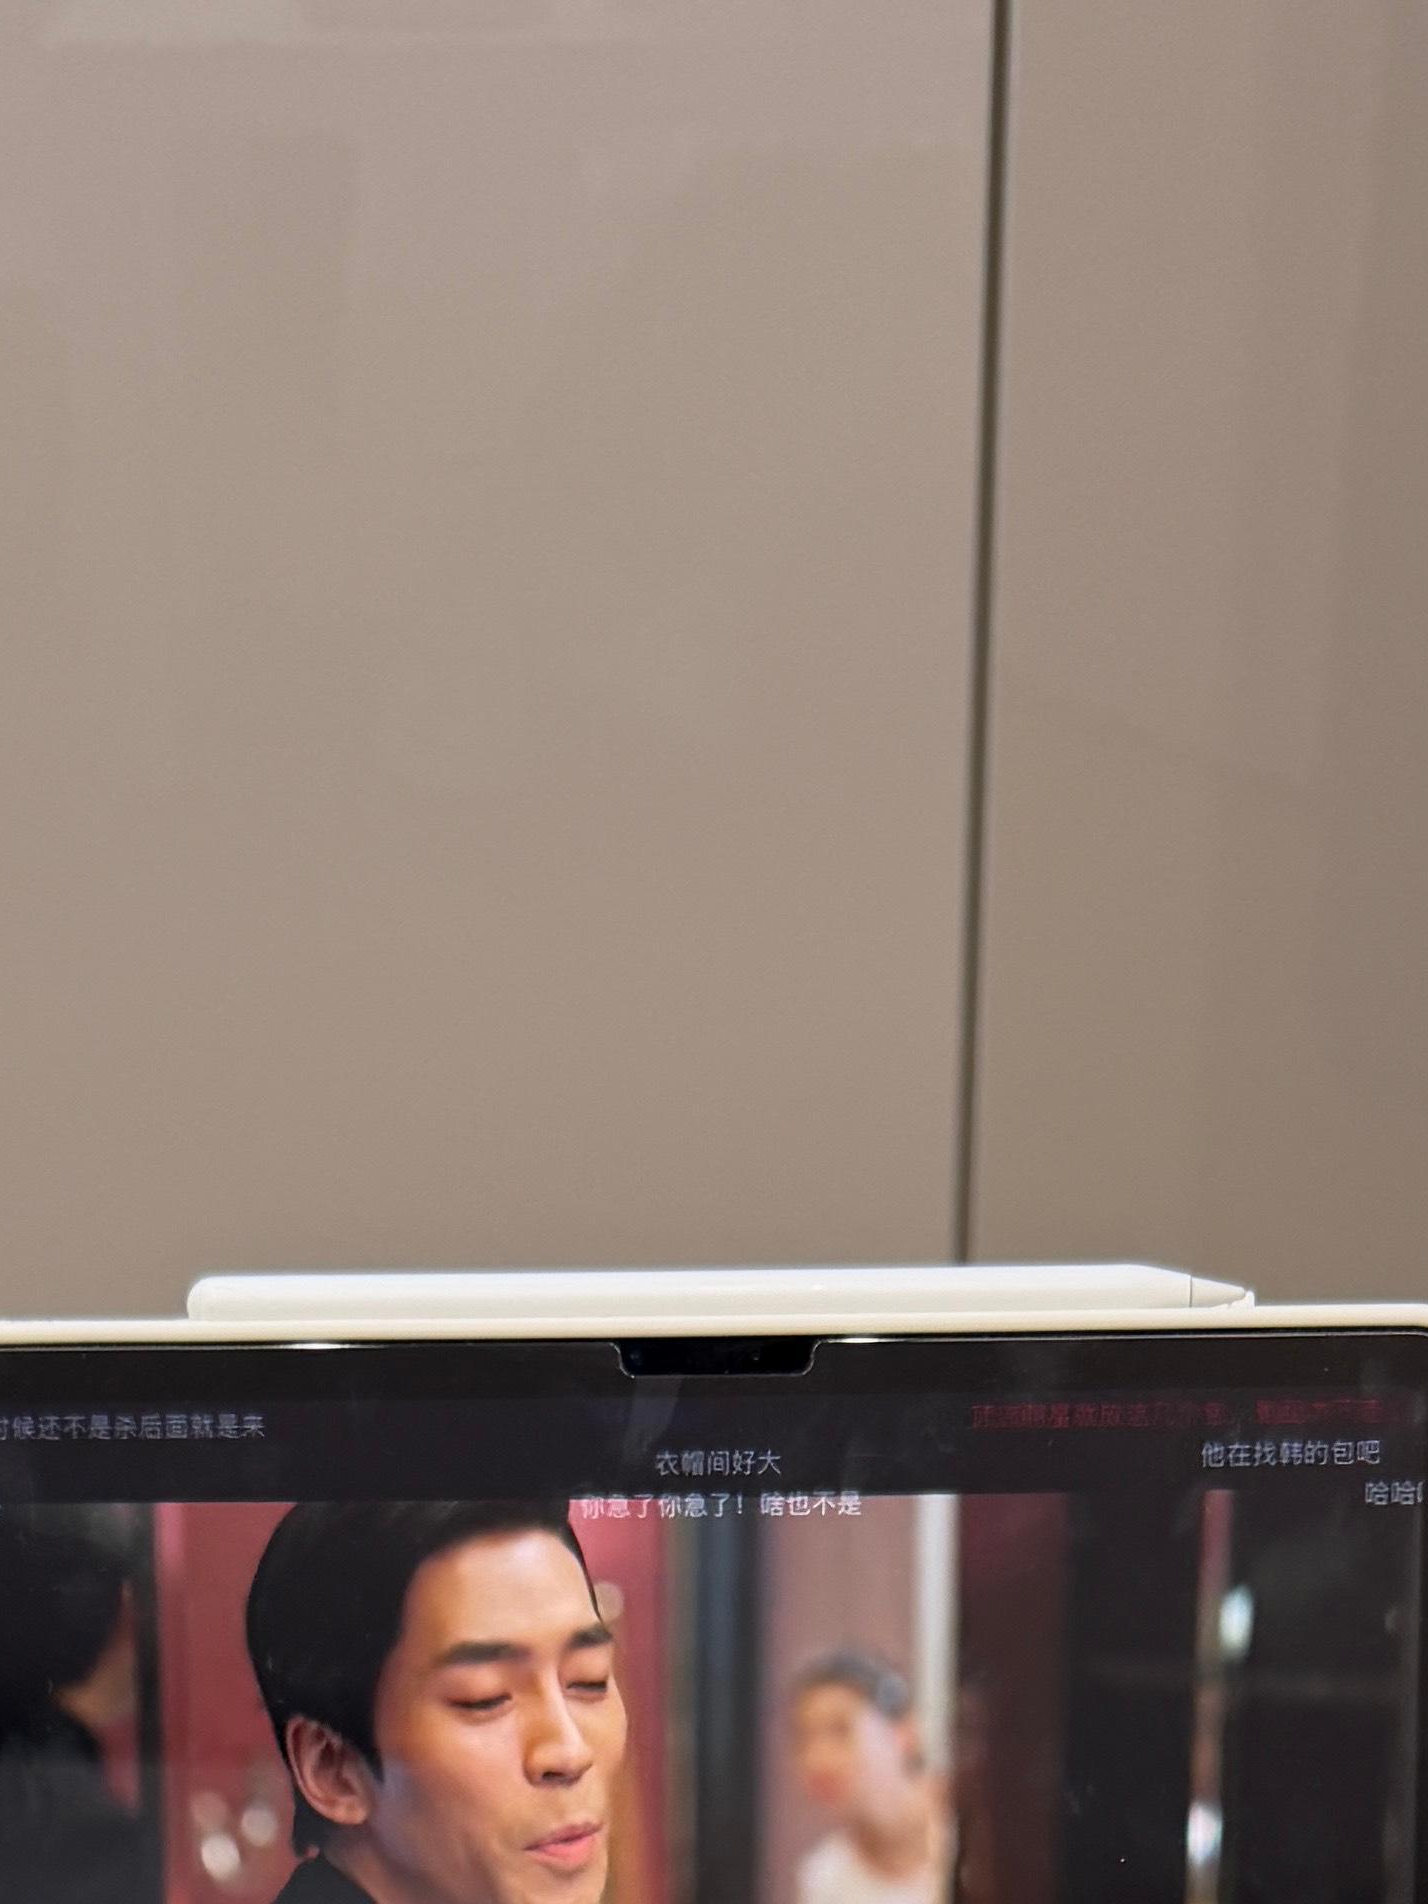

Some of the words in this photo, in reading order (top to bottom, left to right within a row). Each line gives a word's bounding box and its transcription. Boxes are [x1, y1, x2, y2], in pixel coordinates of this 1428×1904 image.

[655, 1450, 783, 1477] 衣帽间好大
[1201, 1439, 1381, 1468] 他在找韩的包吧
